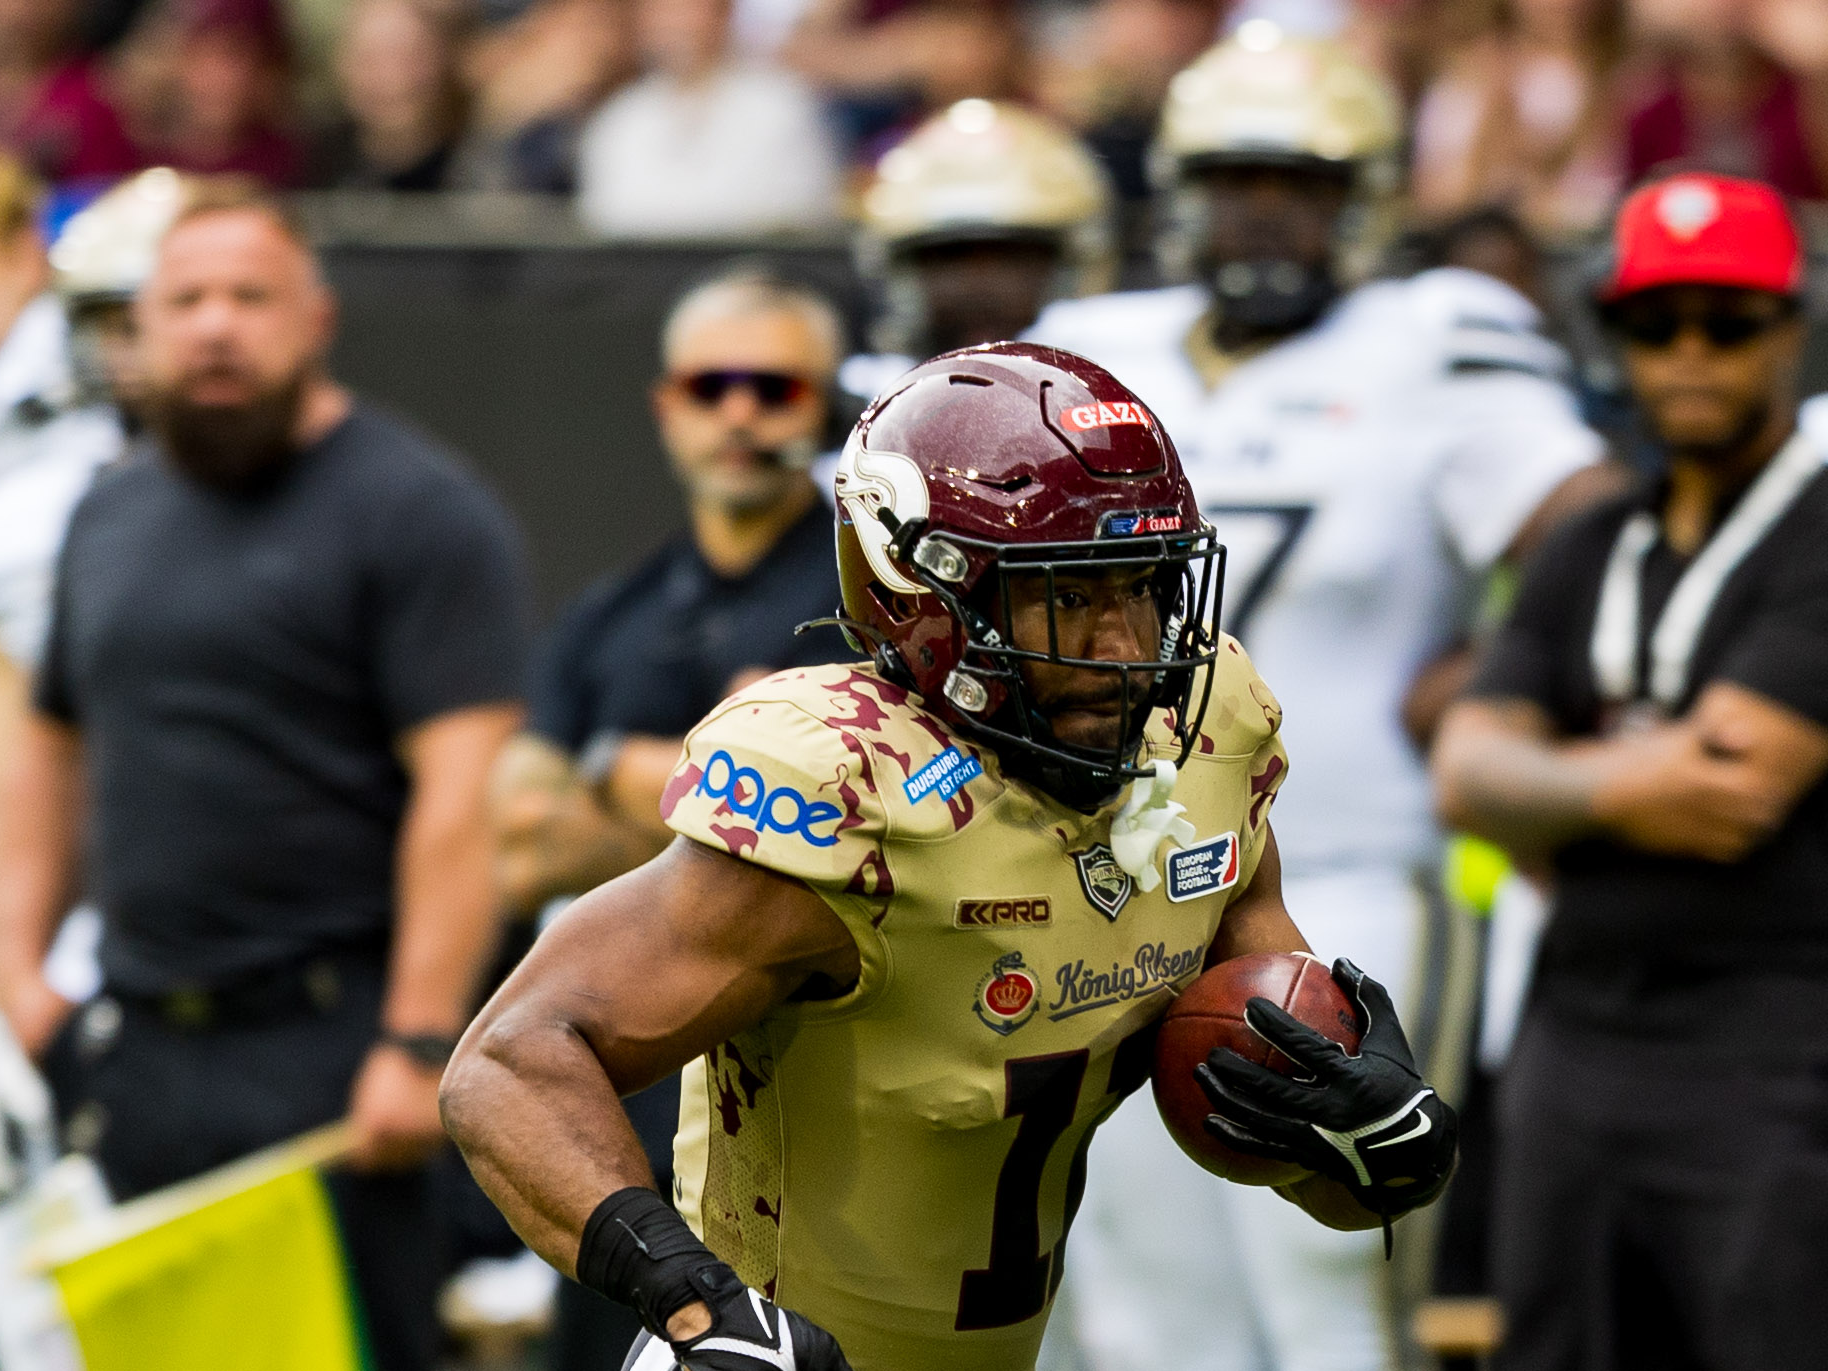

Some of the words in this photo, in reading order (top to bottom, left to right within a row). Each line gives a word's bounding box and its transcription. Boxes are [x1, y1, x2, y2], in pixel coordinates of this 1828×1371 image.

[1071, 401, 1149, 429] GAZI
[1149, 515, 1181, 532] GAZI
[907, 751, 960, 799] DUISBURG
[939, 776, 955, 796] IST
[953, 760, 976, 784] ECHT
[695, 750, 843, 847] pape
[1176, 850, 1213, 869] EUROPEAN
[1177, 865, 1203, 880] LEAGUE
[1177, 874, 1213, 891] FOOTBALL
[1049, 959, 1135, 1010] König
